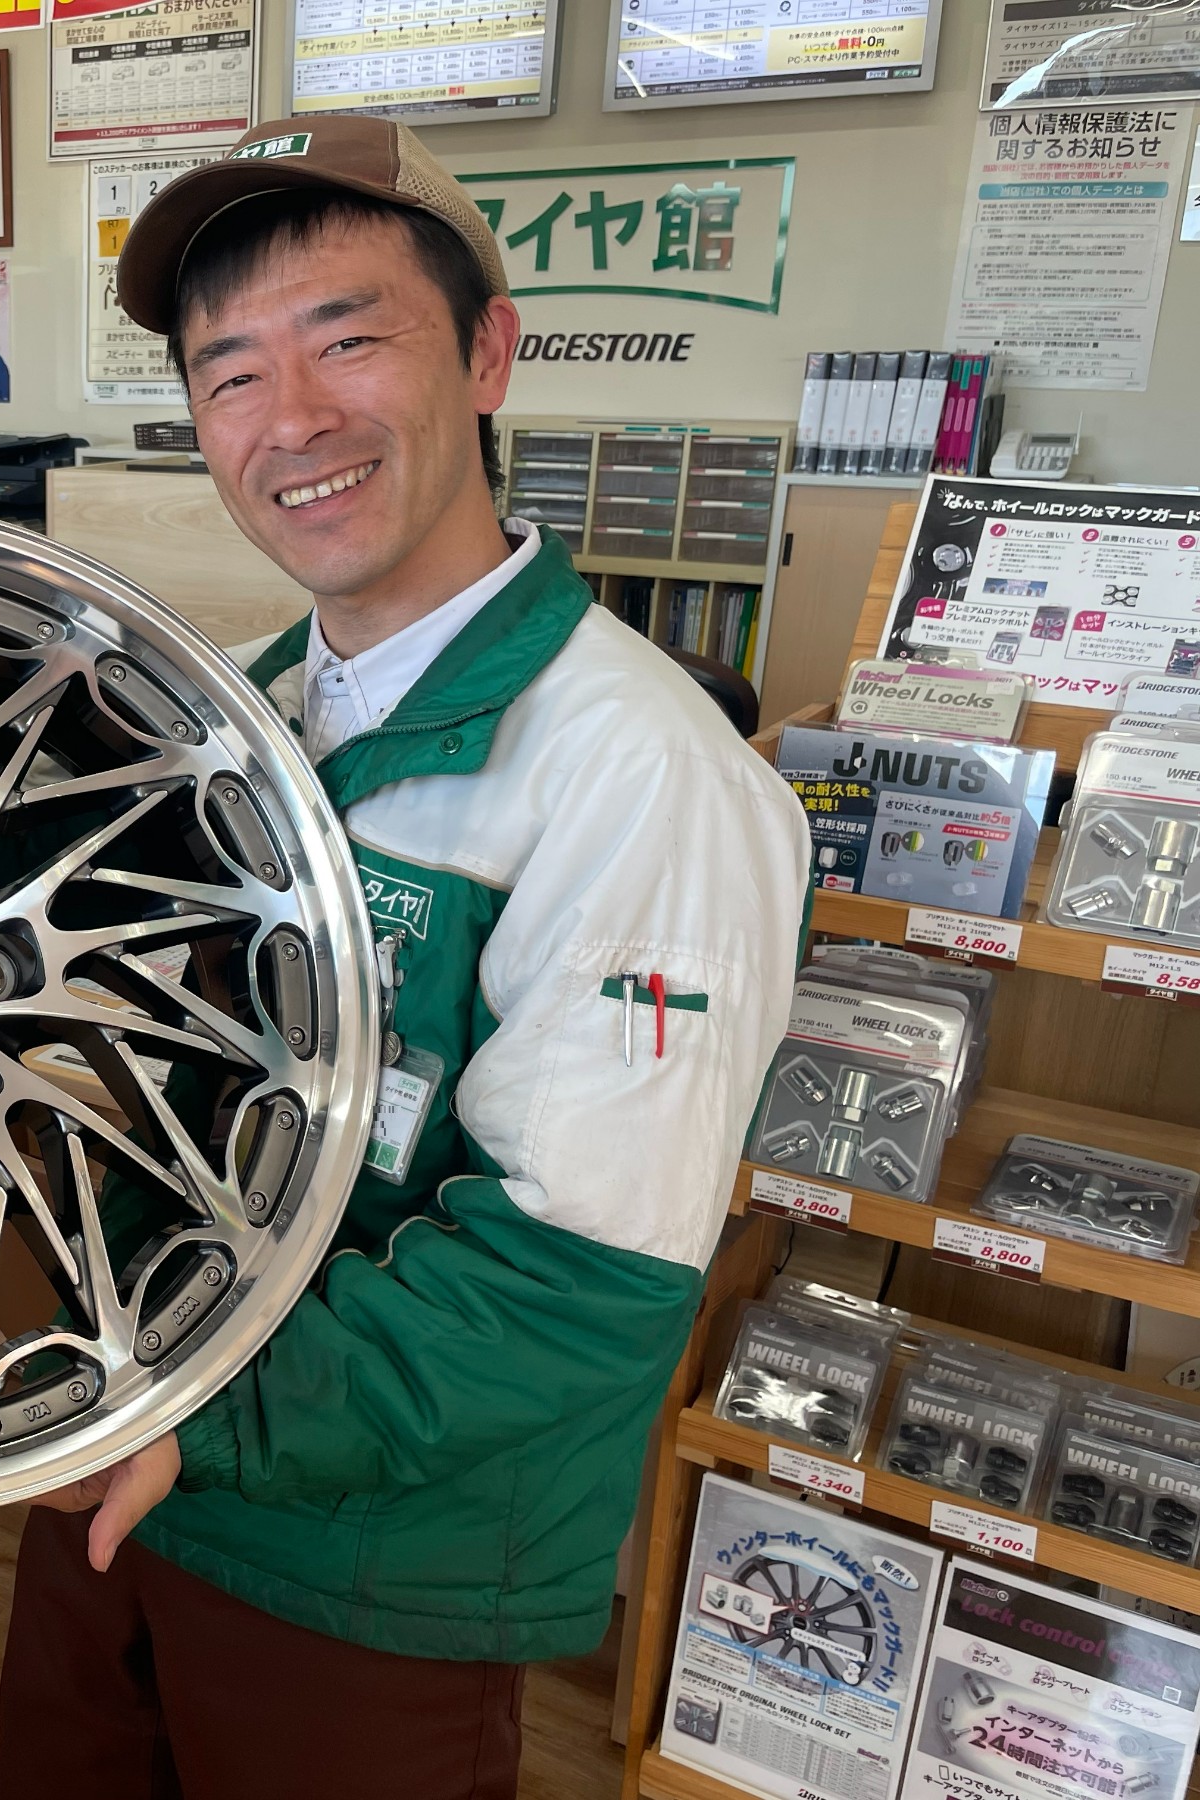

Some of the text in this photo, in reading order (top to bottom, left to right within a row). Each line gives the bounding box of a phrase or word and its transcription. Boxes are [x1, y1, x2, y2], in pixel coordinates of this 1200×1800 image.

[989, 110, 1177, 136] 個人情報保護法に
[996, 137, 1162, 161] 関するお知らせ
[945, 613, 1029, 627] プレミアムロックボルト
[948, 604, 1030, 617] プレミアムロックナット
[851, 681, 995, 709] Wheel Locks
[788, 781, 871, 797] 異の耐久性を
[804, 797, 839, 812] 実現!
[365, 879, 426, 924] タイヤ
[954, 935, 1006, 954] 8,800
[798, 988, 863, 1007] BRIDGESTONE
[852, 1015, 926, 1038] WHEEL LOCK
[1084, 1156, 1125, 1169] WHEEL
[1165, 1175, 1192, 1183] SET
[793, 1197, 839, 1216] 8,800
[980, 1246, 1031, 1265] 8,800
[747, 1341, 870, 1393] WHEEL LOCK
[23, 1401, 52, 1422] VIA
[907, 1398, 1038, 1450] WHEEL LOCK
[1067, 1447, 1138, 1480] WHEEL
[808, 1475, 852, 1494] 2,340
[977, 1531, 1023, 1552] 1,100
[961, 1595, 1106, 1658] Lock control
[972, 1650, 1000, 1663] ホイール
[1033, 1677, 1054, 1689] ロック
[1034, 1670, 1091, 1695] ナンバープレート
[682, 1667, 852, 1740] BRIDGESTONE ORIGINAL WHEEL LOCK SET
[985, 1716, 1125, 1775] インターネットから
[968, 1726, 1128, 1798] 24時間注文可能!
